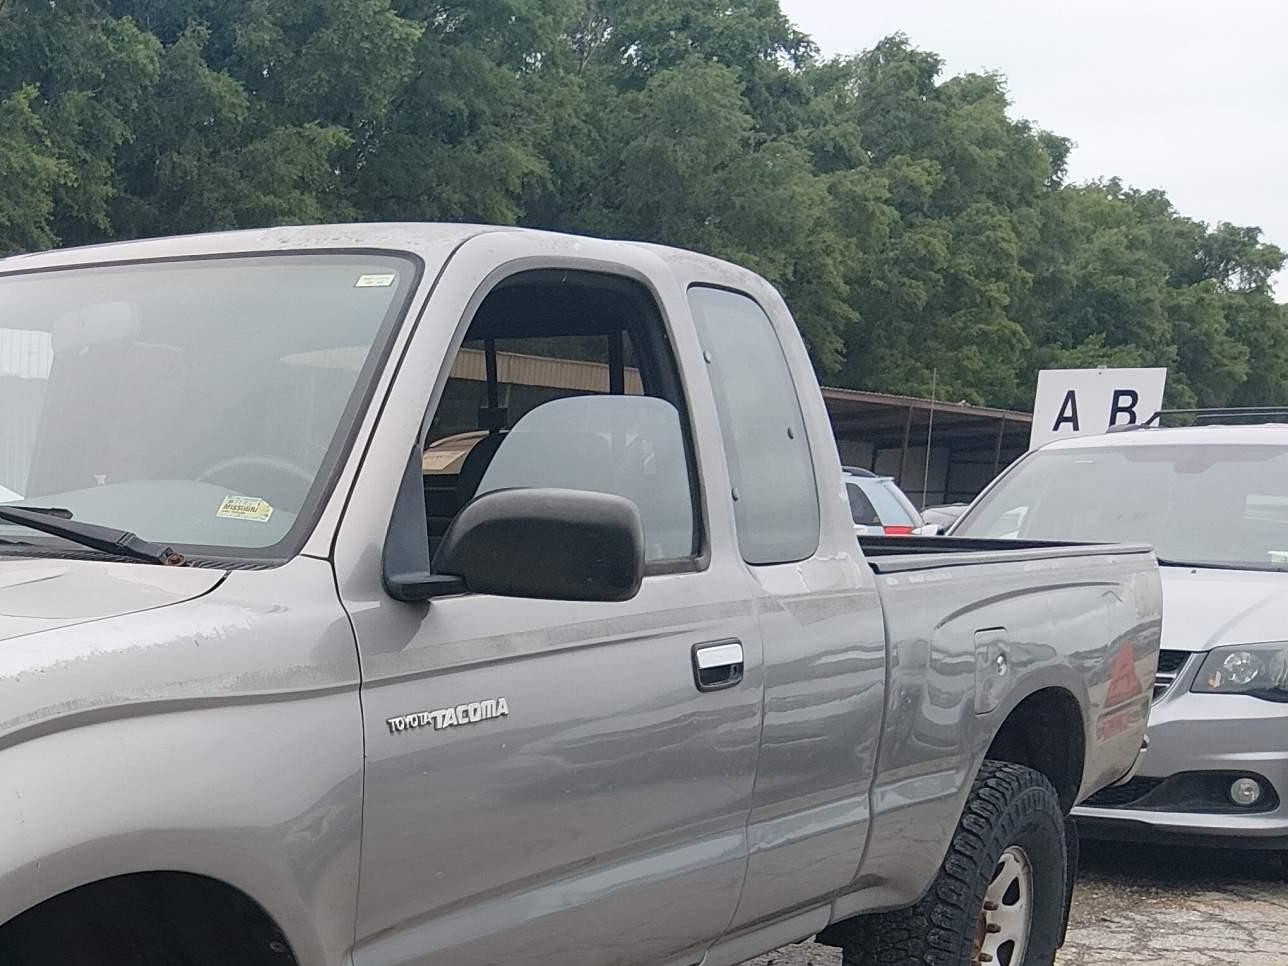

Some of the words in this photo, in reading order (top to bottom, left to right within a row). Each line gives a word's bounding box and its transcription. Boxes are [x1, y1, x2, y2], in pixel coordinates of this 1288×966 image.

[1052, 389, 1080, 432] A
[1109, 389, 1139, 428] B
[387, 711, 432, 732] TOYOTA
[431, 697, 509, 730] TACOMA
